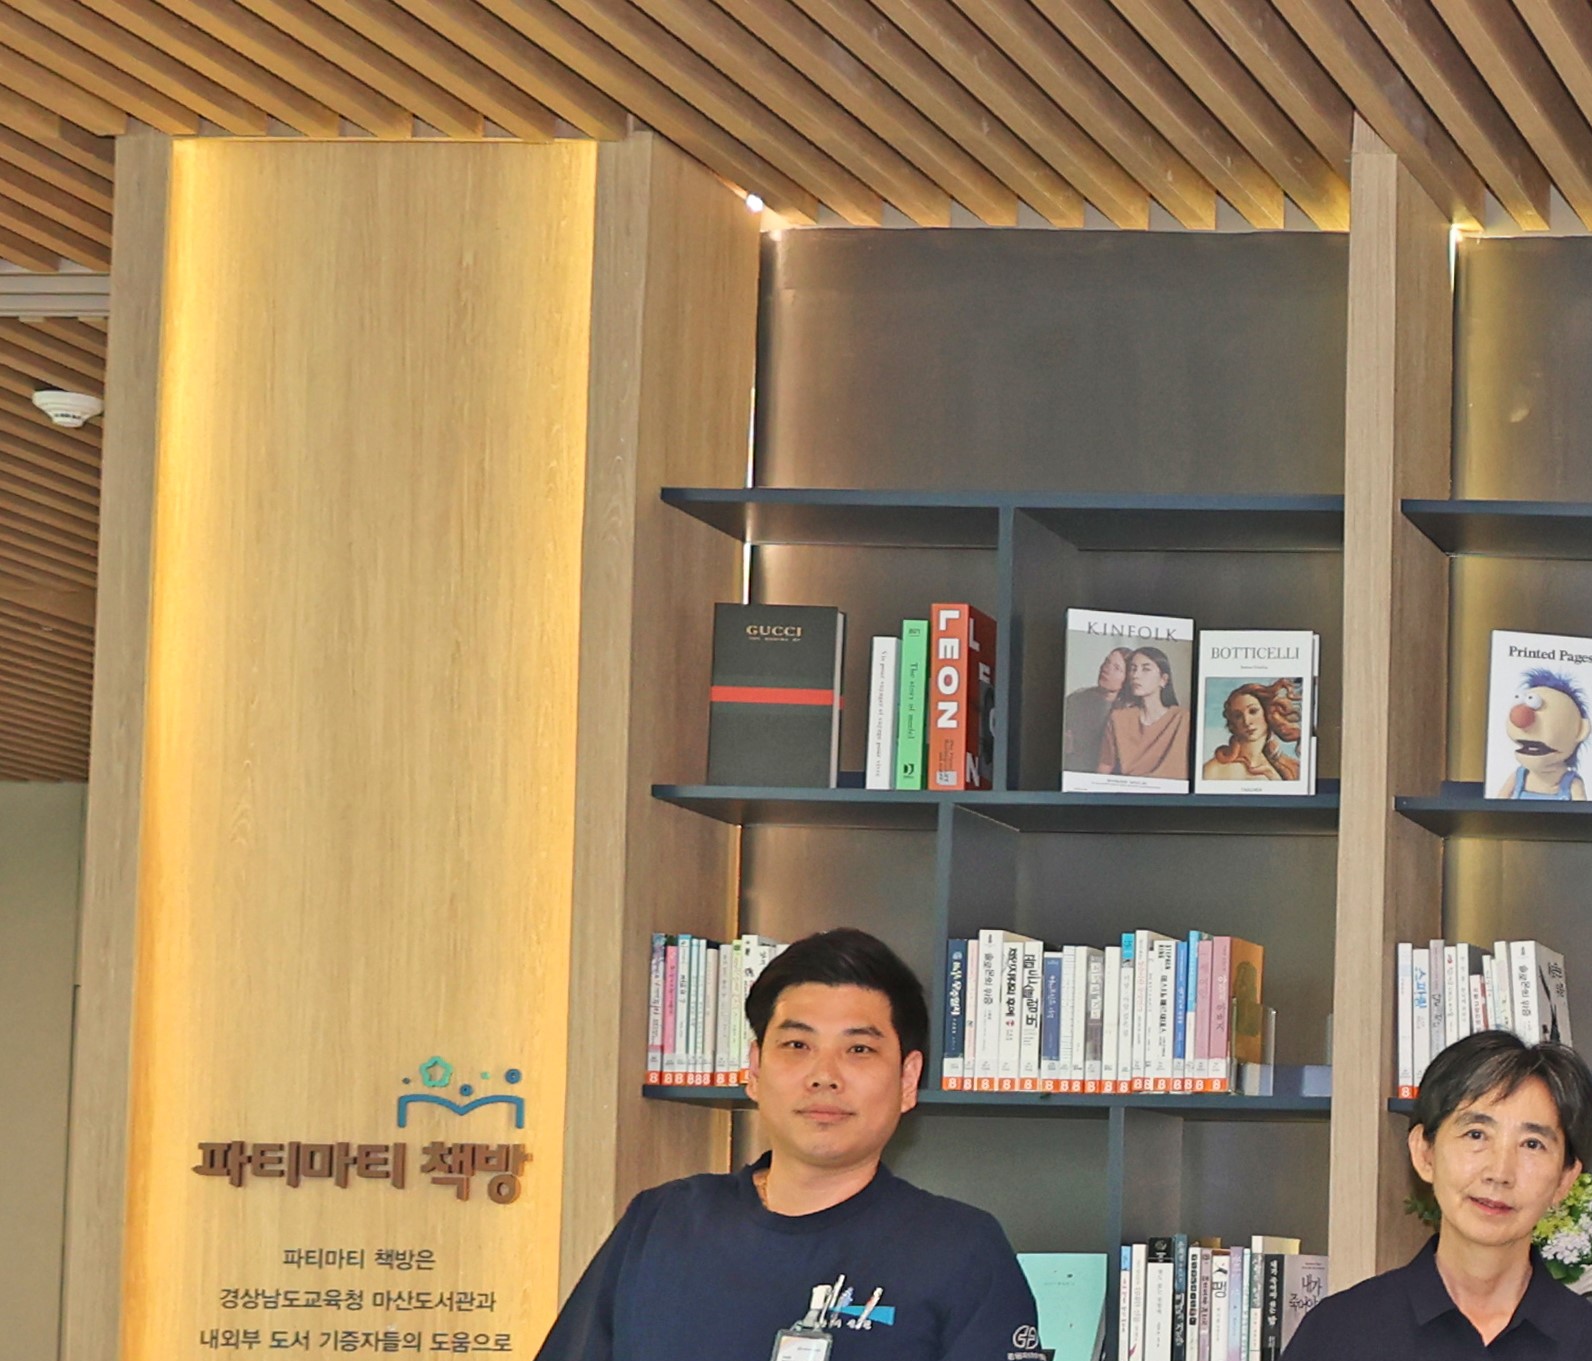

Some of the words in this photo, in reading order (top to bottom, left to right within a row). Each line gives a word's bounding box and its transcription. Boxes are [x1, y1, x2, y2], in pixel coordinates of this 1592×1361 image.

[745, 624, 802, 637] GUCCI
[1087, 621, 1178, 643] KINFOLK
[1211, 646, 1299, 660] BOTTICELLI
[1508, 646, 1556, 661] Printed
[909, 662, 918, 678] The
[937, 609, 960, 729] LEON
[649, 1071, 659, 1083] 8
[674, 1071, 685, 1085] 8
[947, 1077, 958, 1090] 8
[963, 1077, 973, 1091] 8
[1045, 1079, 1054, 1092] 8
[1156, 1078, 1167, 1091] 8
[1401, 1086, 1411, 1099] 8
[192, 1140, 407, 1189] 파티마티
[420, 1140, 534, 1204] 책방
[282, 1248, 366, 1271] 파티마티
[374, 1249, 437, 1272] 책방은
[219, 1288, 364, 1312] 경상남도교육청
[373, 1290, 496, 1313] 마산도서관과
[200, 1328, 262, 1351] 내외부
[269, 1330, 310, 1351] 도서
[320, 1330, 422, 1353] 기증자들의
[429, 1332, 513, 1354] 도움으로
